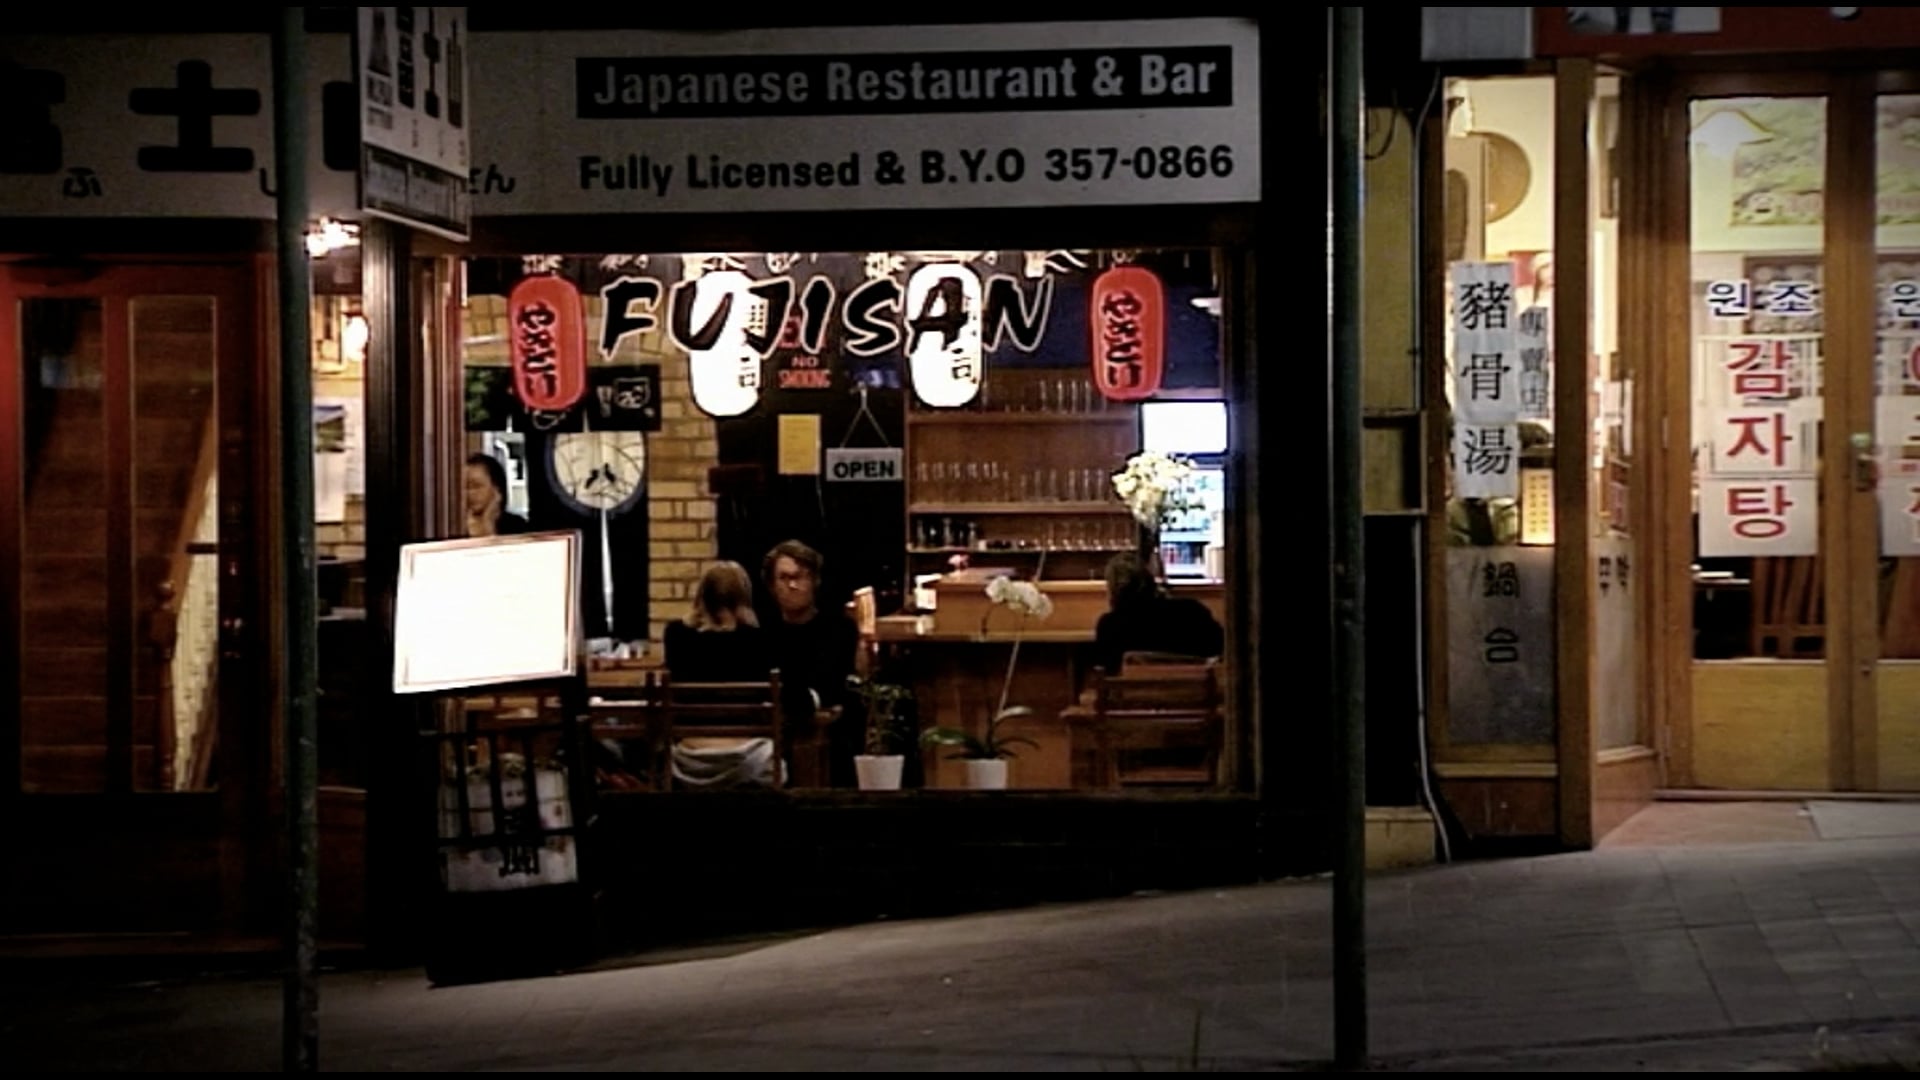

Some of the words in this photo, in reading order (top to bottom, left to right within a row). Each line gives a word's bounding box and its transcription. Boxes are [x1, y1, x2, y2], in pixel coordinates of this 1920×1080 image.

[594, 66, 809, 113] Japanese
[827, 57, 1077, 101] Restaurant
[1092, 56, 1124, 96] &
[1140, 54, 1217, 95] Bar
[577, 153, 673, 197] Fully
[686, 152, 860, 188] Licensed
[874, 151, 905, 185] &
[921, 148, 1025, 183] B.Y.O
[1044, 144, 1234, 181] 357-0866
[600, 271, 1054, 361] FUJISAN
[1708, 282, 1813, 317] 원조
[791, 356, 819, 368] NO
[1460, 281, 1513, 476] 豬骨湯
[1726, 341, 1794, 539] 감자탕
[833, 461, 895, 479] OPEN
